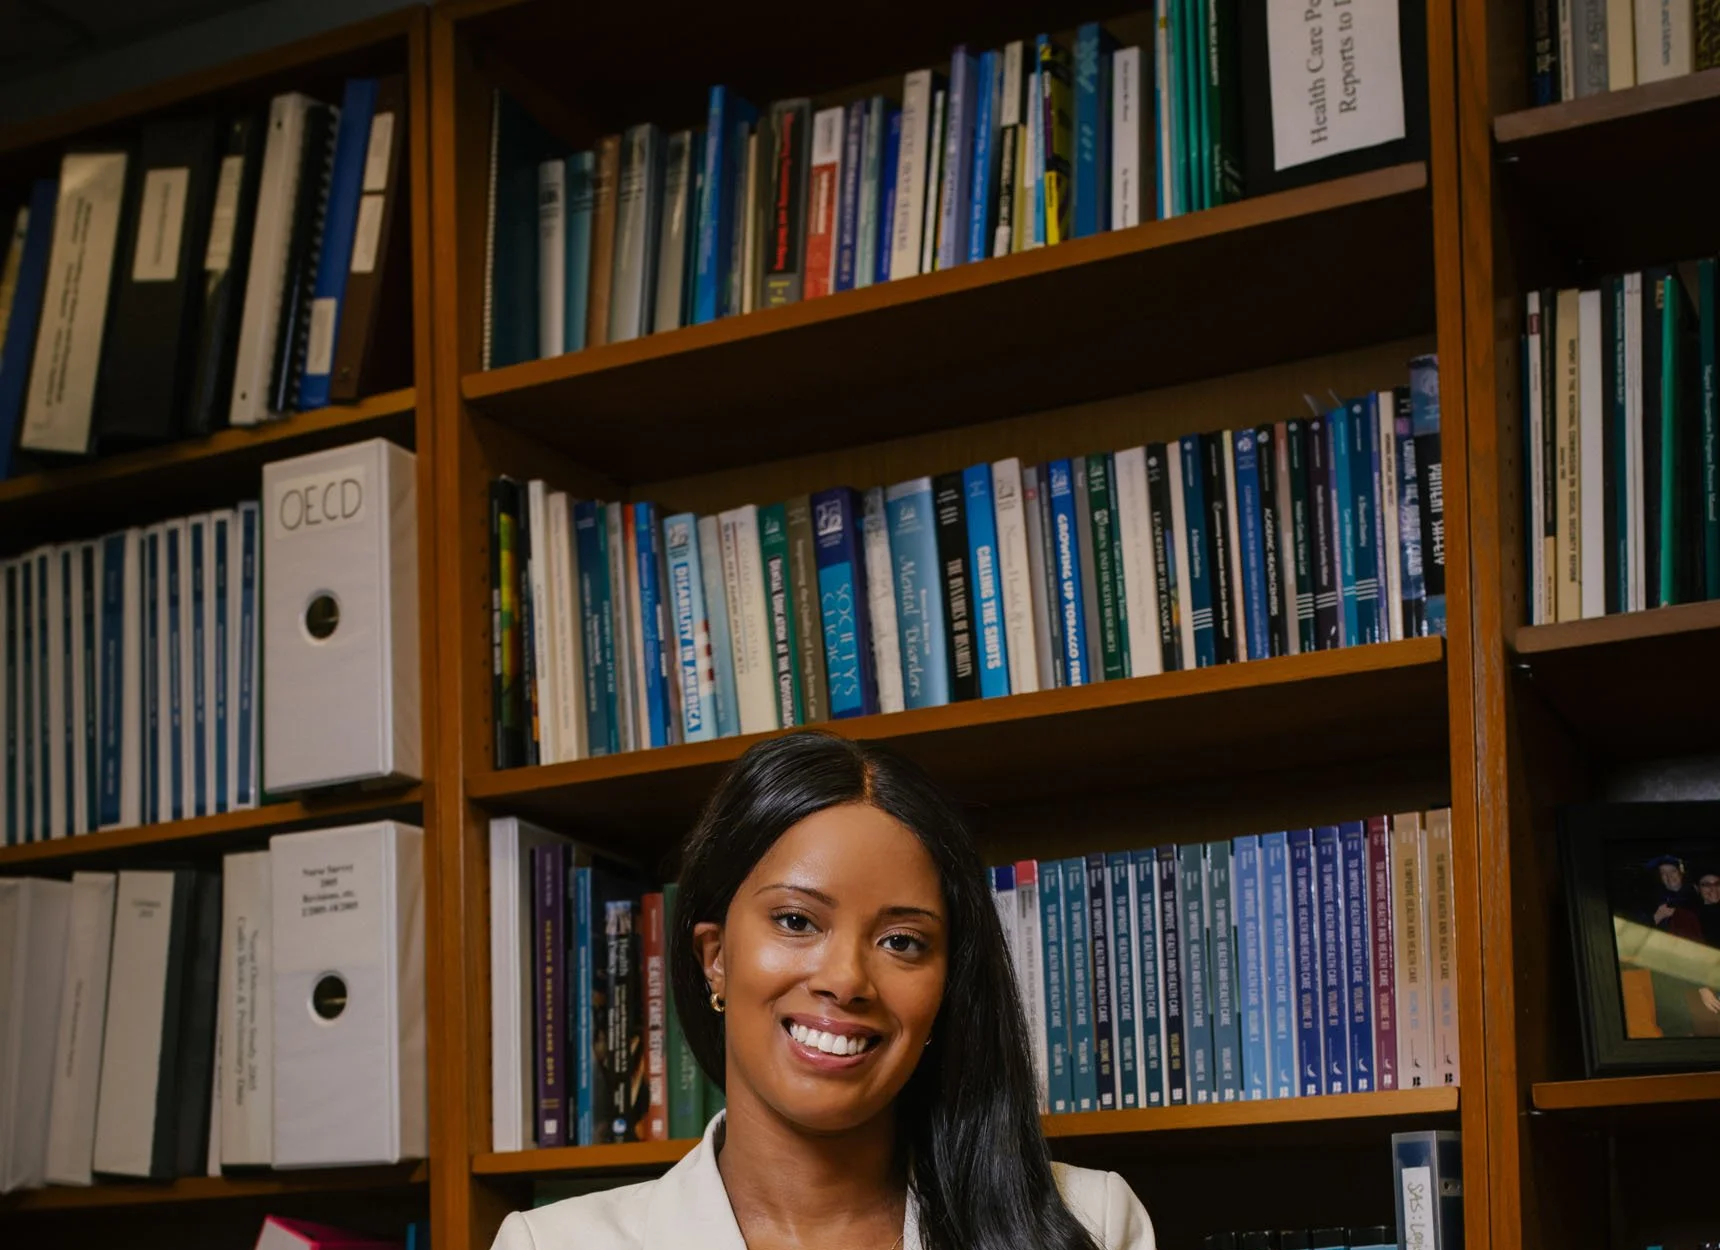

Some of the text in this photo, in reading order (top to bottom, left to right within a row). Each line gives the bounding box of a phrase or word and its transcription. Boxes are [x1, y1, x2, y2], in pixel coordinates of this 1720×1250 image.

[1306, 26, 1324, 73] Care
[1339, 11, 1361, 113] Reports to
[1308, 78, 1328, 144] Health
[279, 478, 362, 530] OECD
[1429, 463, 1446, 566] PATIENT SAFETY
[1265, 508, 1275, 551] ACADEMIC
[1056, 513, 1073, 579] GROWING
[946, 558, 964, 577] THE
[1154, 512, 1172, 643] LEADERSHIP BY EXAMPLE
[1267, 552, 1277, 581] HEALTH
[801, 588, 810, 602] the
[1062, 581, 1074, 598] UP
[1101, 571, 1112, 606] HEALTH
[801, 604, 812, 638] Quality
[976, 545, 1002, 670] CALLING THE SHOTS
[900, 555, 925, 697] Mental Disorders
[1064, 602, 1078, 658] TOBACCO
[1103, 607, 1116, 653] RESEARCH
[674, 565, 700, 728] DISABILITY IN AMERICA
[803, 639, 813, 648] of
[808, 699, 817, 719] Care
[1297, 867, 1306, 876] TO
[1092, 898, 1102, 908] TO
[1297, 877, 1307, 906] IMPROVE
[1092, 909, 1104, 937] IMPROVE
[1298, 908, 1308, 932] HEALTH
[544, 920, 552, 962] HEALTH
[1094, 940, 1105, 964] HEALTH
[1299, 933, 1309, 946] AND
[544, 966, 553, 974] &
[619, 938, 629, 976] Health
[1095, 965, 1106, 979] AND
[1300, 946, 1310, 971] HEALTH
[648, 956, 662, 997] HEALTH
[1301, 972, 1310, 989] CARE
[544, 978, 554, 1021] HEALTH
[1096, 980, 1107, 1004] HEALTH
[1301, 993, 1311, 1020] VOLUME
[648, 998, 662, 1029] CARE
[1097, 1005, 1107, 1023] CARE
[545, 1024, 554, 1053] CARE
[649, 1030, 663, 1074] REFORM
[1099, 1039, 1109, 1061] VOLUME
[1406, 1182, 1425, 1221] SAS:
